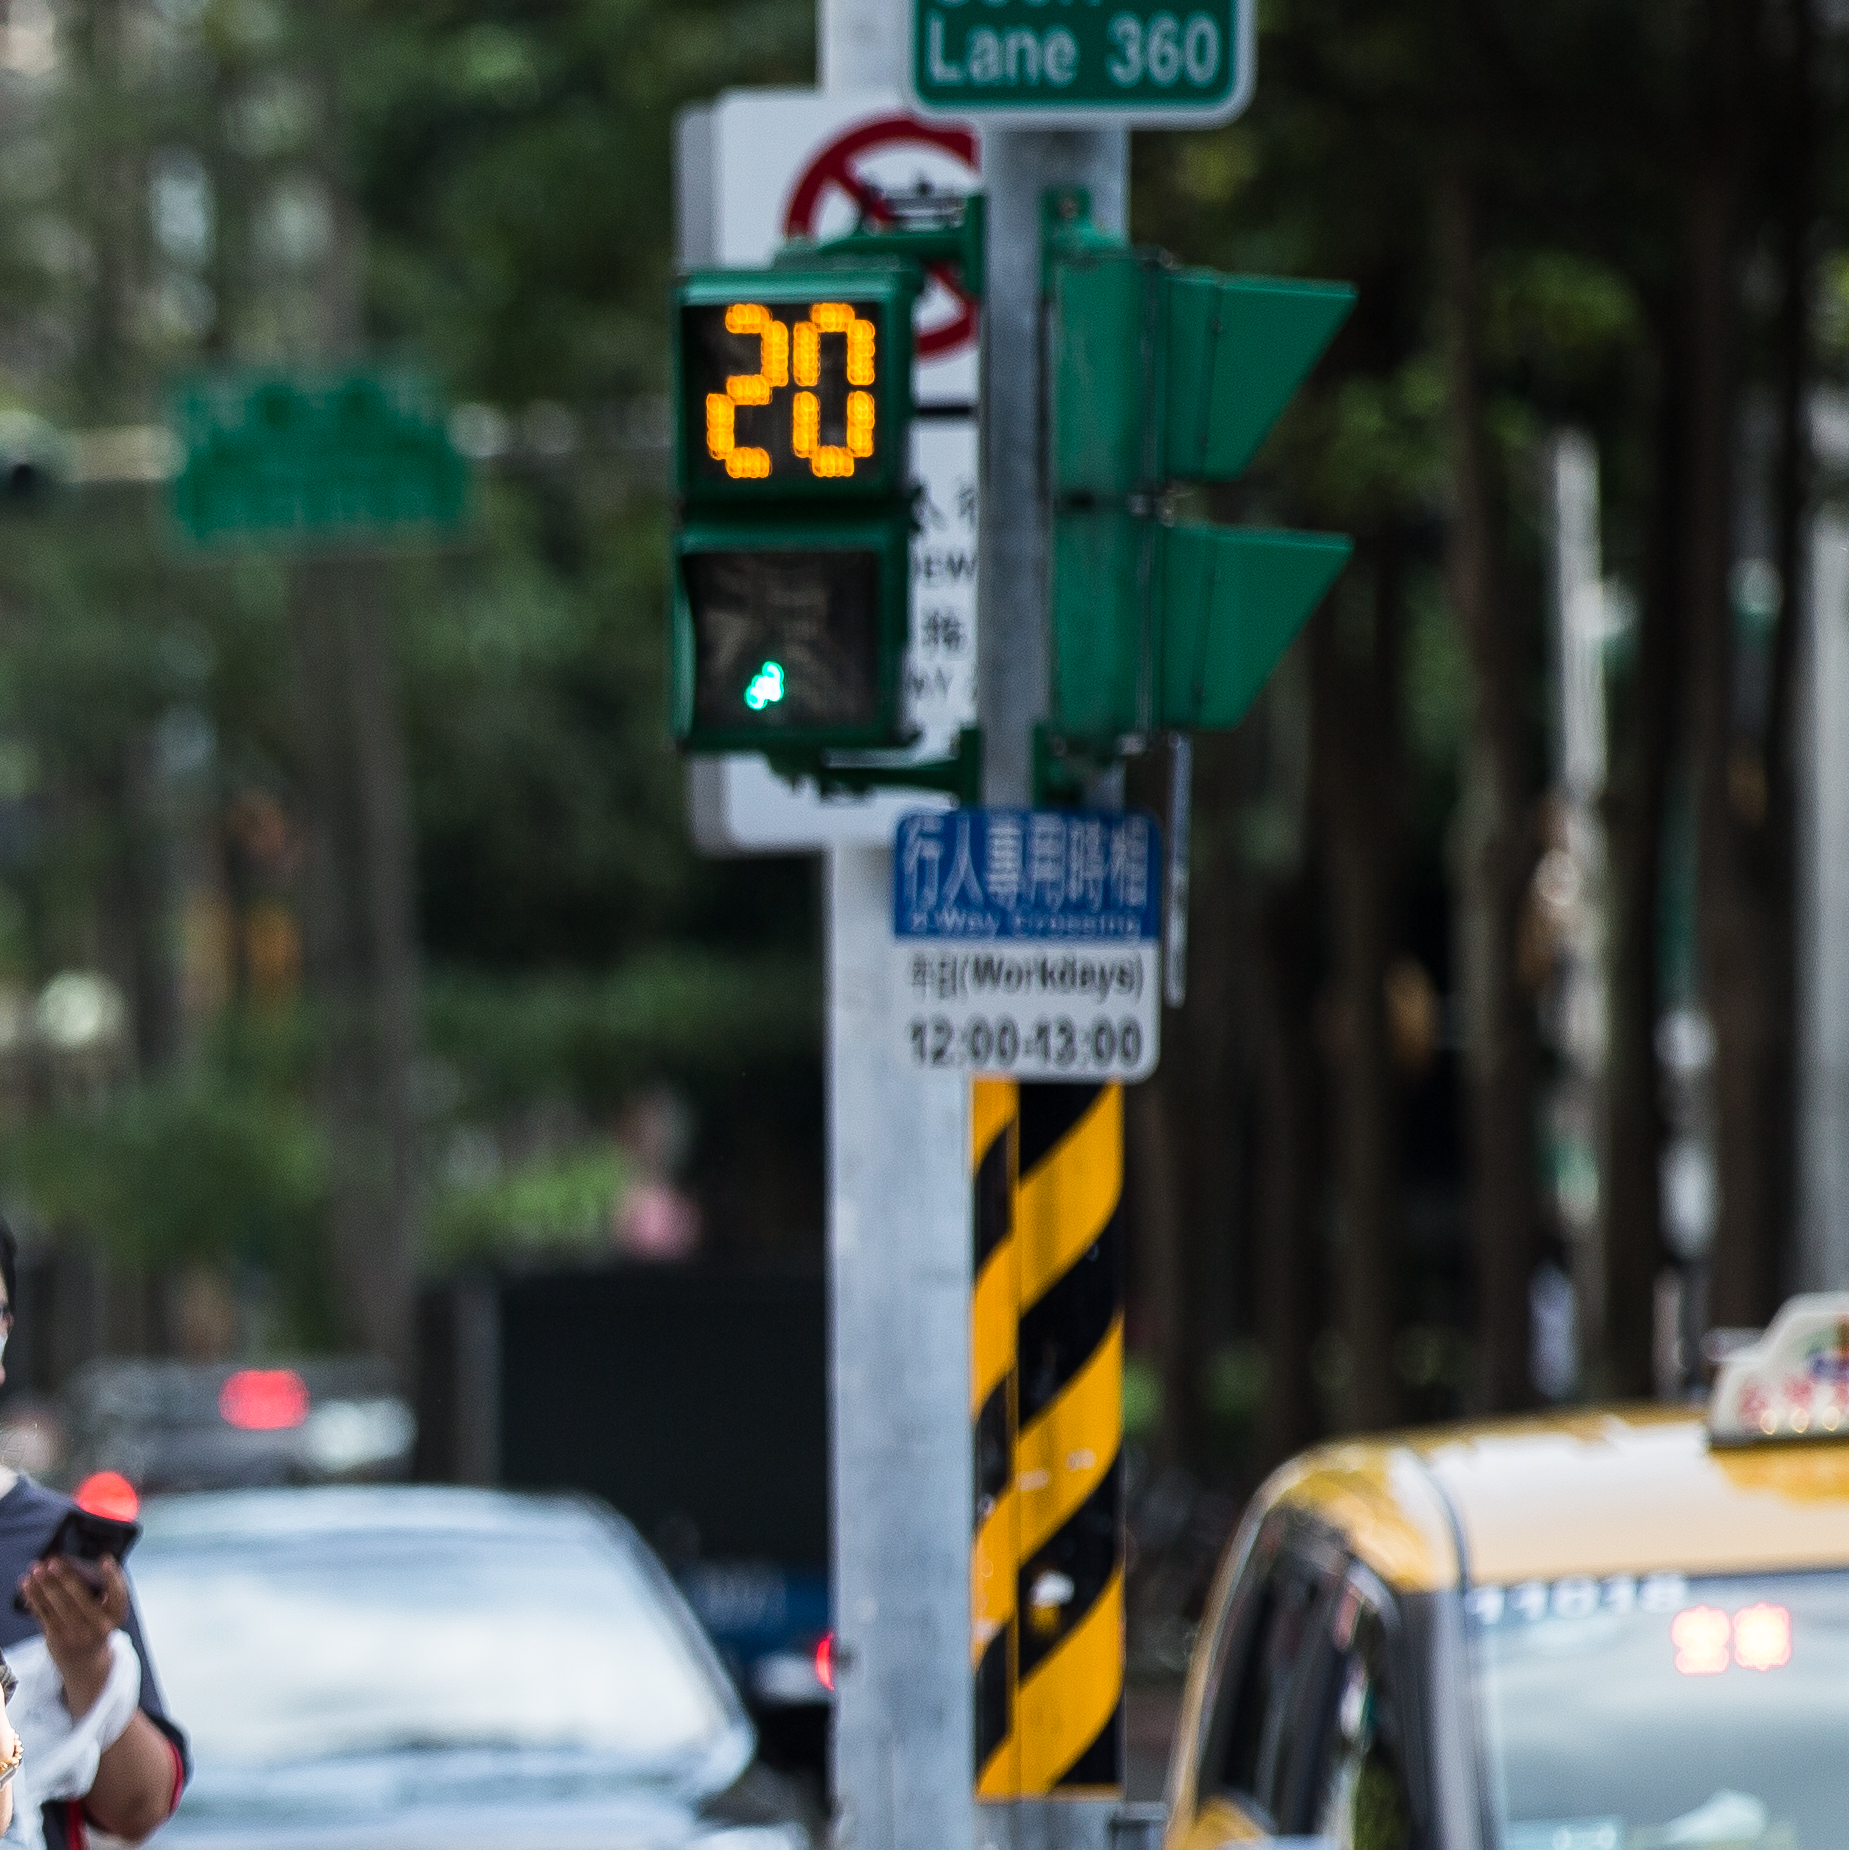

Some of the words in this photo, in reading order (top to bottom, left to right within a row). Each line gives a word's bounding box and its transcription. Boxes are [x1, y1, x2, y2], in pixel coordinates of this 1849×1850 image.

[928, 9, 1078, 88] Lane
[1105, 10, 1221, 88] 360
[706, 303, 875, 479] 20
[909, 1013, 1143, 1069] 12:00-13:00
